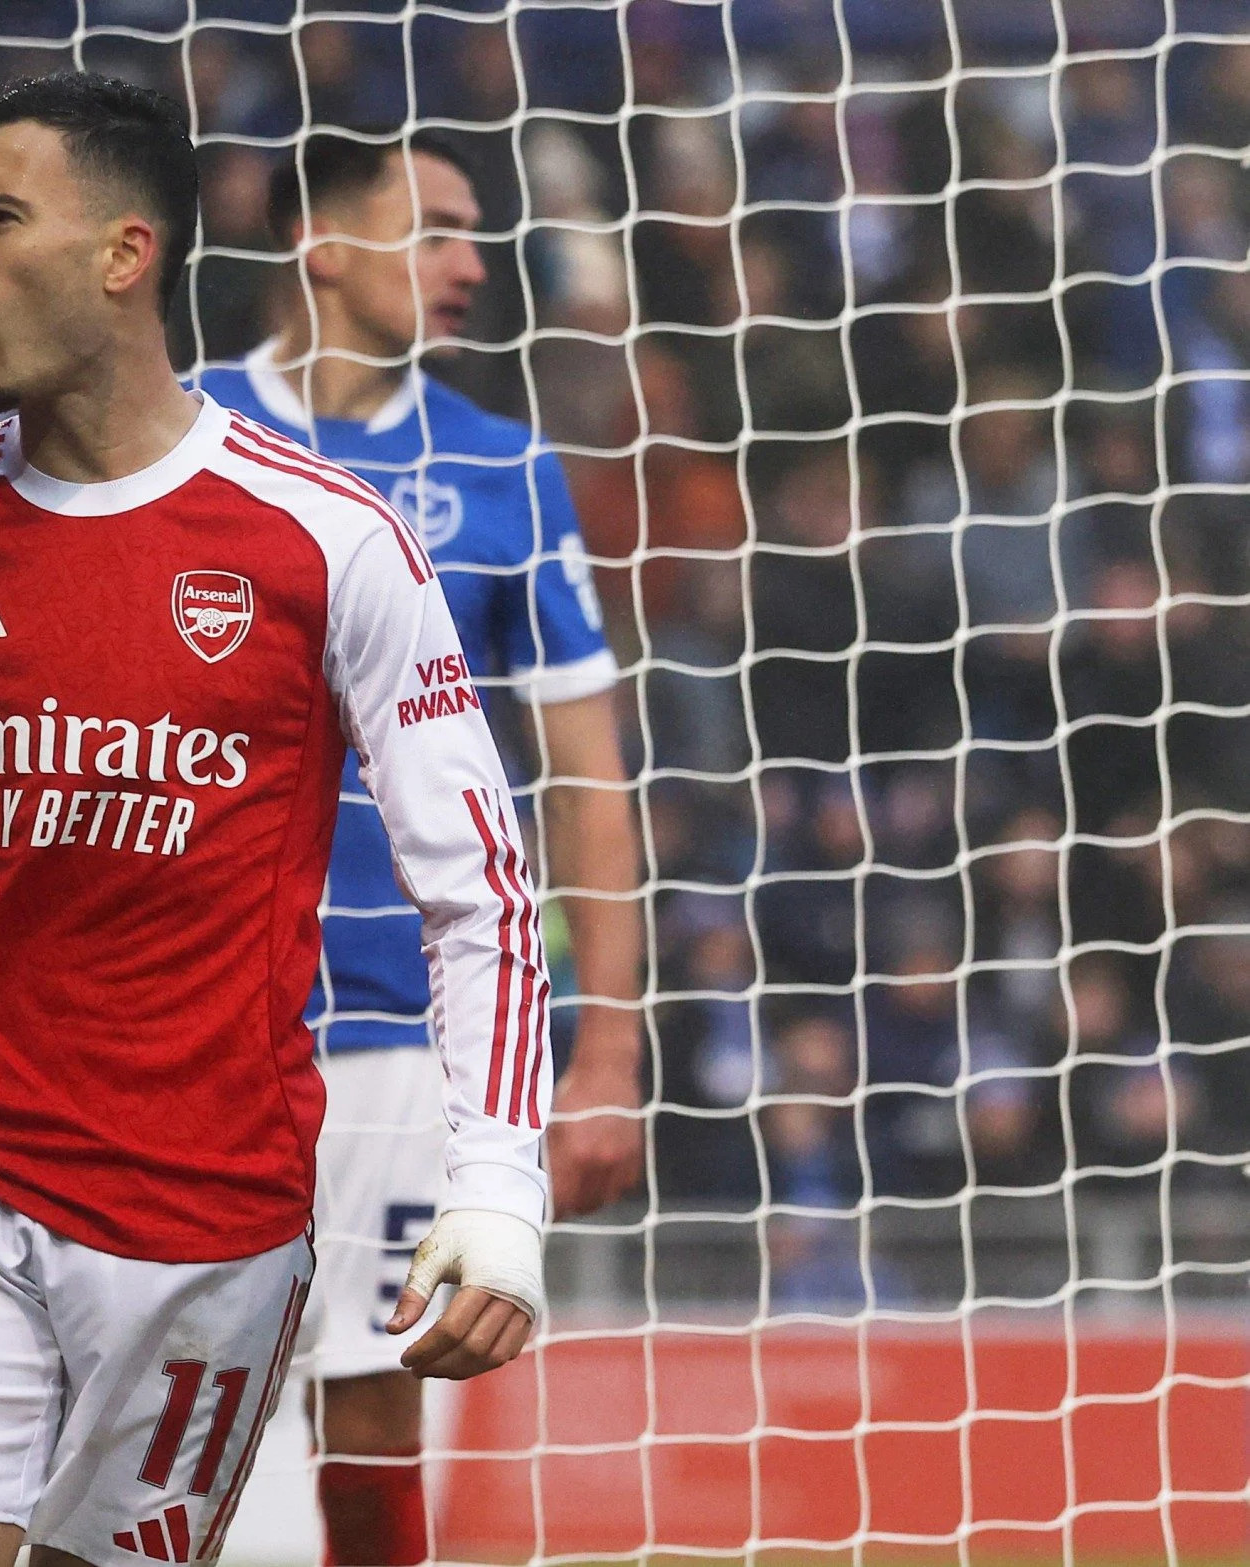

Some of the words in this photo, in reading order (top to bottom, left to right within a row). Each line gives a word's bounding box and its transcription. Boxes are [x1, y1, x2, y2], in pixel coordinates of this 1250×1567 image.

[183, 585, 242, 604] Arsenal
[30, 788, 196, 856] BETTER
[137, 1359, 251, 1497] 11
